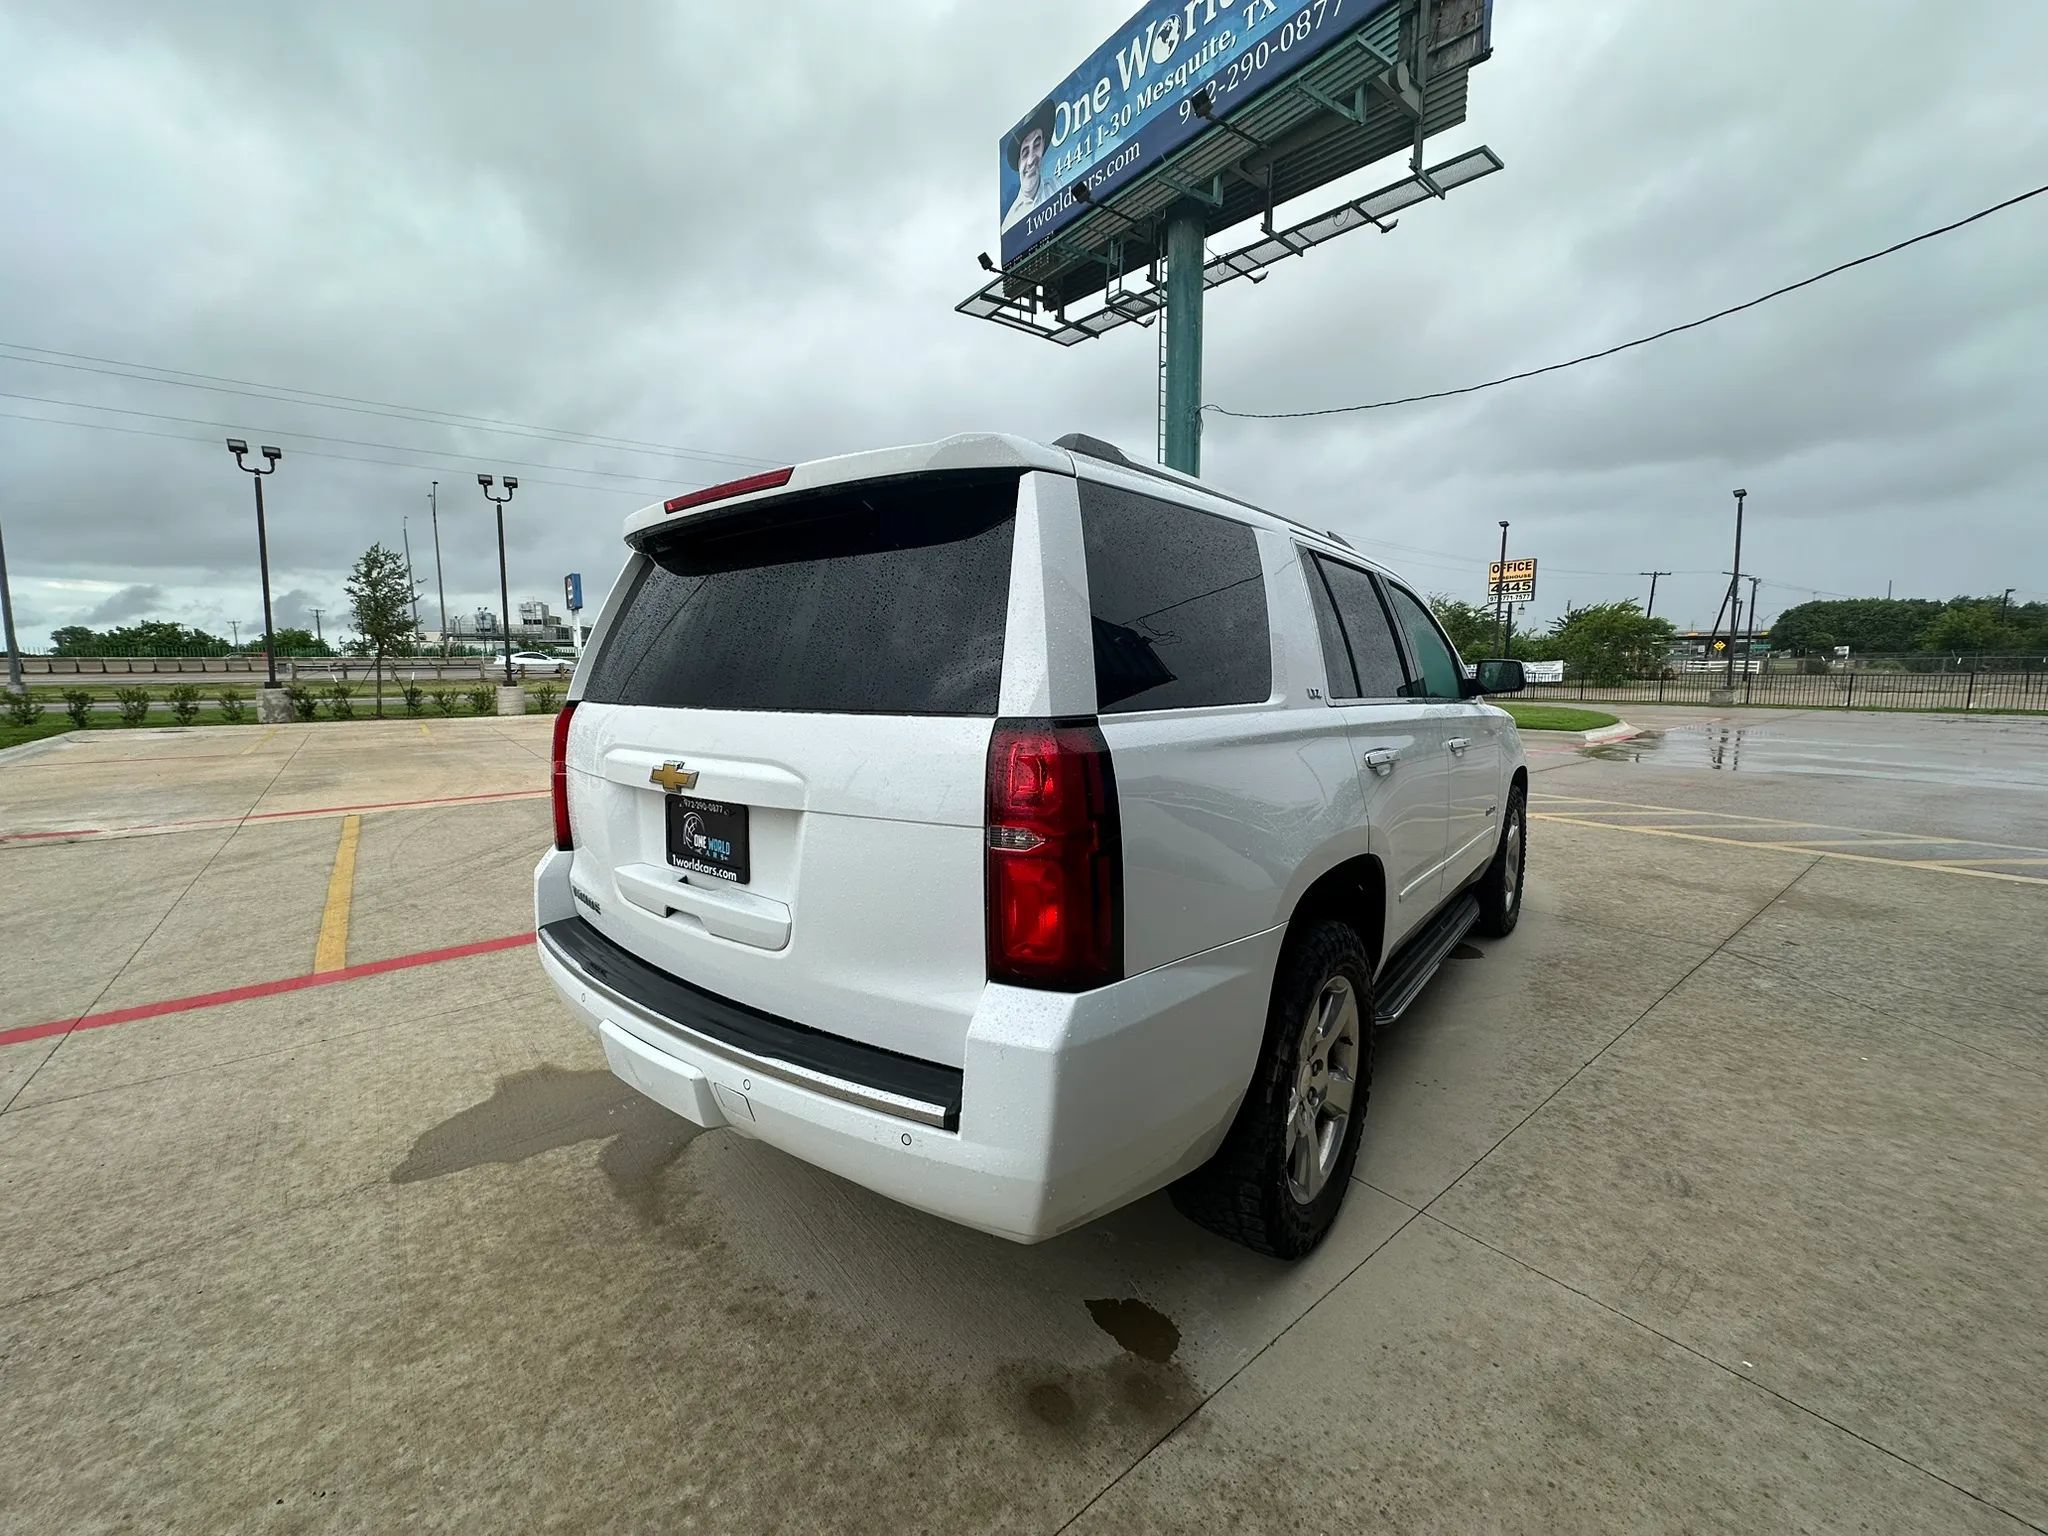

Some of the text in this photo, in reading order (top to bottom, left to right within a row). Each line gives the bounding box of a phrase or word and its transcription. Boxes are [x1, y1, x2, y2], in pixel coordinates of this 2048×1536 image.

[1051, 76, 1111, 147] One
[1054, 134, 1093, 178] 4441
[1097, 103, 1132, 148] I-30
[1136, 29, 1237, 117] Mesquite,
[1025, 141, 1141, 236] 1worldrs.com
[672, 853, 737, 881] 1worldcars.com
[693, 833, 730, 855] ONE WORLD
